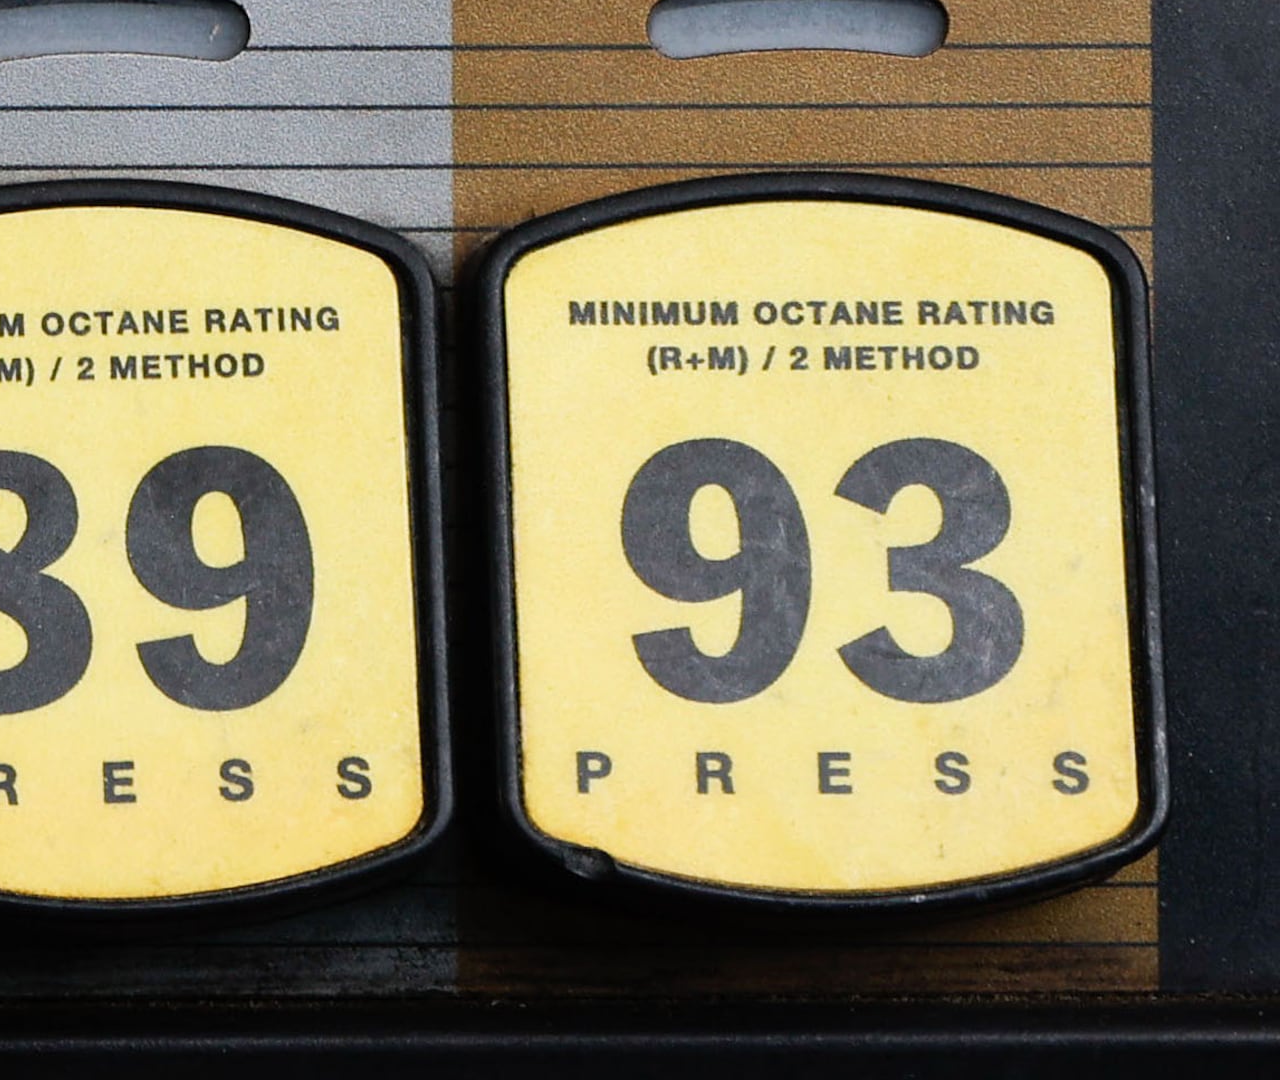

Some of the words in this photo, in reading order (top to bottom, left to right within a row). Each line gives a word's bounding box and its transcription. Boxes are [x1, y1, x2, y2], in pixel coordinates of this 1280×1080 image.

[41, 309, 189, 338] OCTANE
[204, 306, 341, 334] RATING
[568, 301, 739, 326] MINIMUM
[752, 301, 902, 326] OCTANE
[918, 301, 1054, 326] RATING
[50, 358, 62, 382] /
[77, 357, 96, 381] 2
[109, 354, 266, 380] METHOD
[647, 345, 749, 376] (R+M)
[762, 346, 776, 371] /
[789, 346, 809, 371] 2
[824, 345, 979, 371] METHOD
[620, 437, 1025, 704] 93
